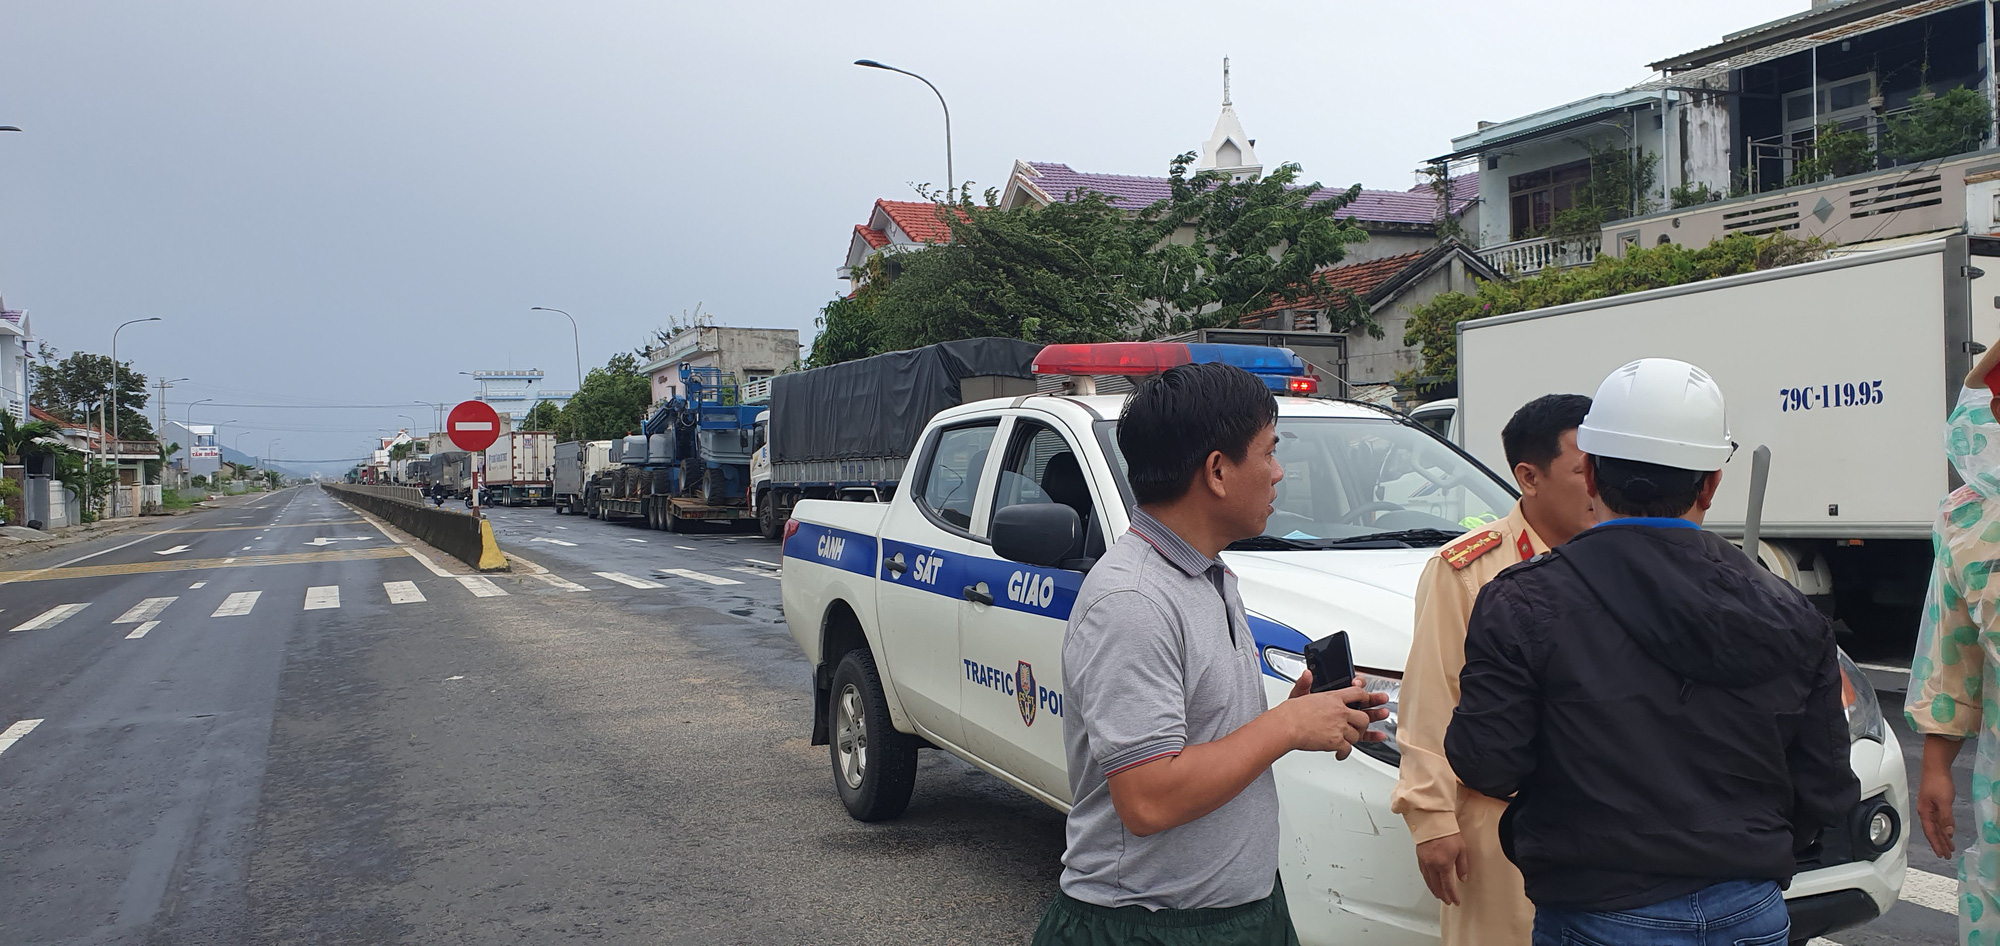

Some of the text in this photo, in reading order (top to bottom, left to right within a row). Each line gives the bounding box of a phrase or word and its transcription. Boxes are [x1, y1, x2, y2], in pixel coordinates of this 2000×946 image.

[1779, 379, 1884, 412] 79C-119.95
[817, 529, 1055, 609] CẢNH SÁT GIAO
[963, 658, 1014, 697] TRAFFIC
